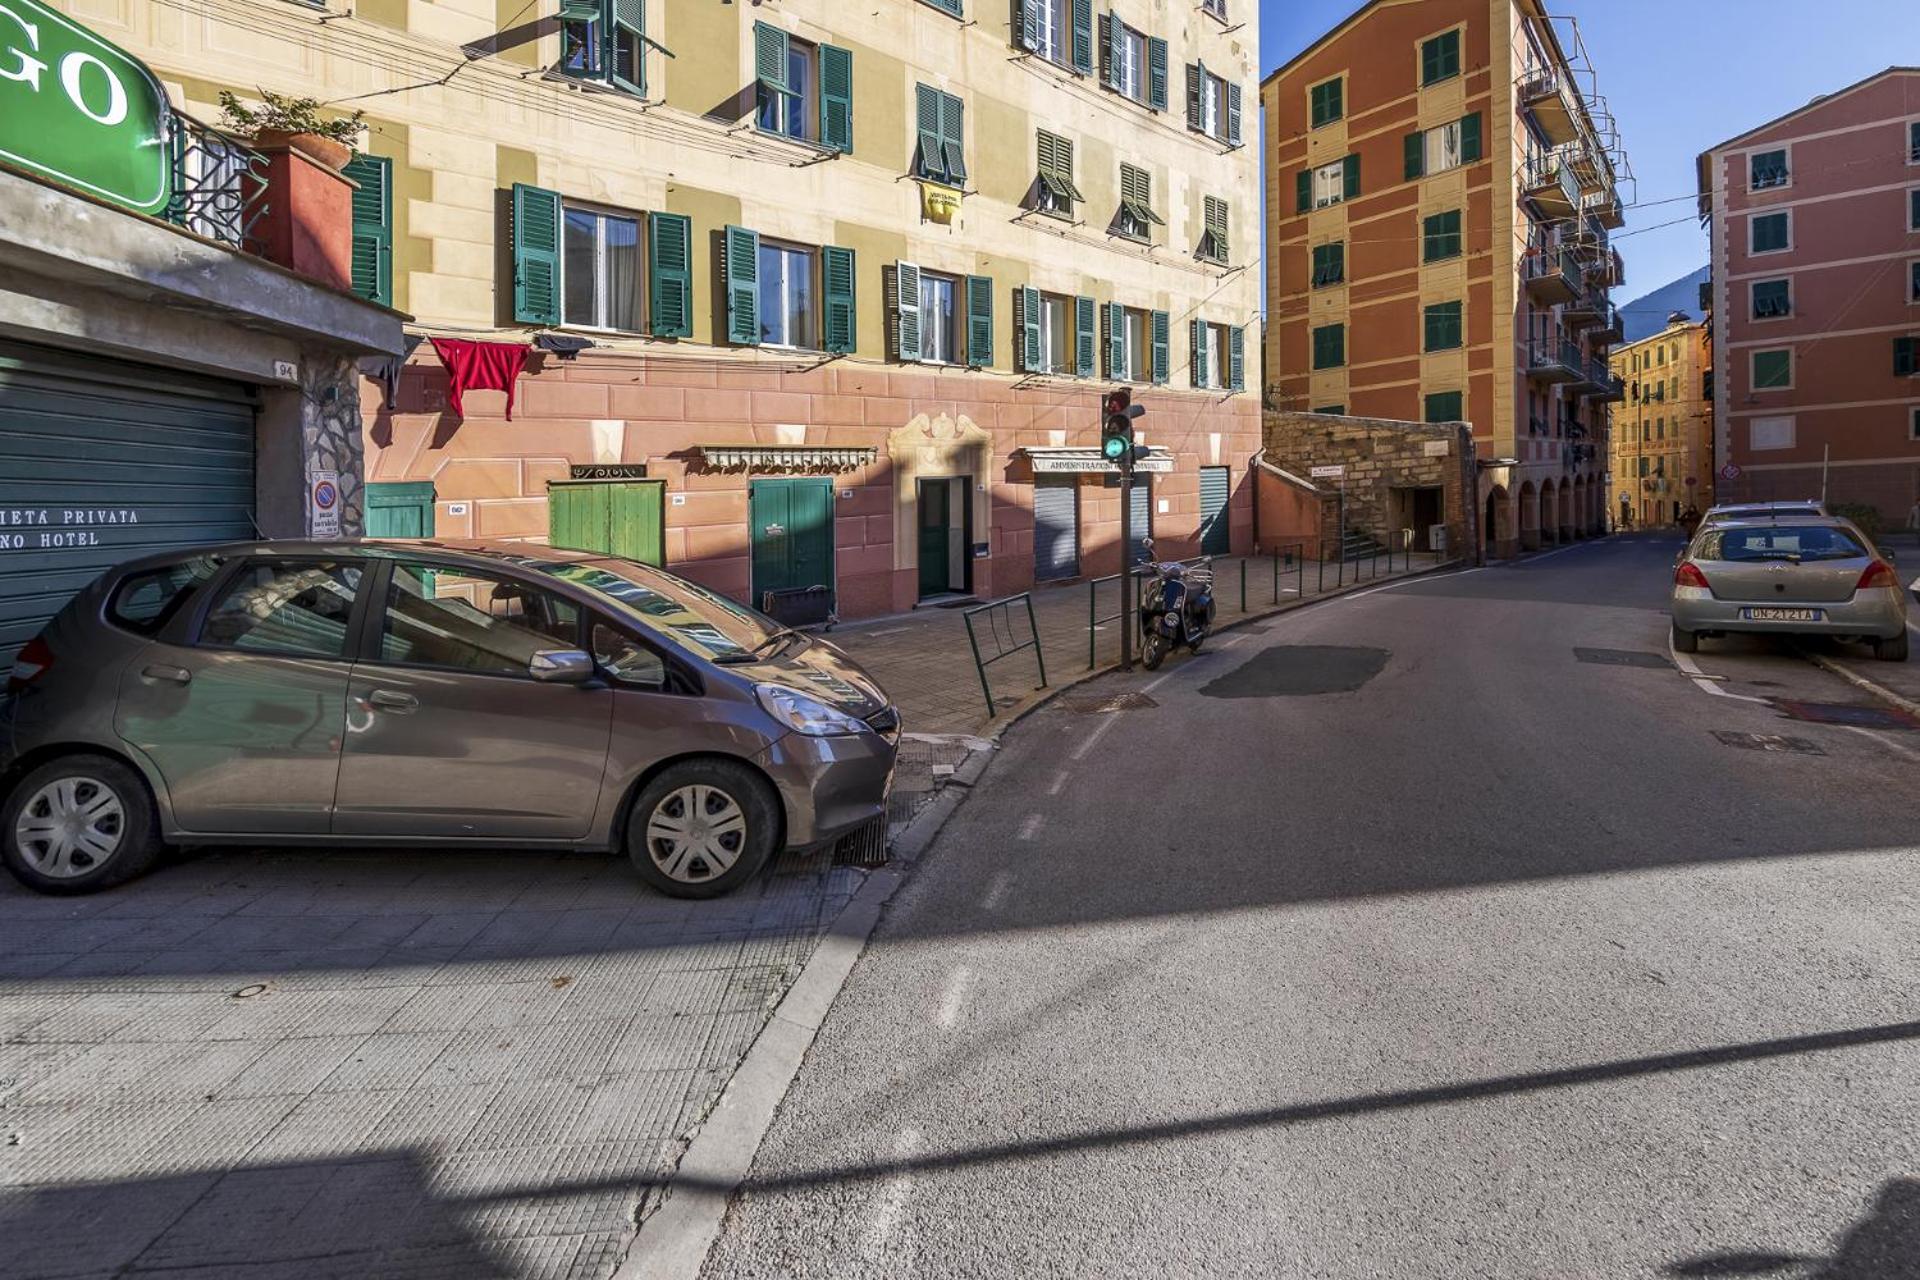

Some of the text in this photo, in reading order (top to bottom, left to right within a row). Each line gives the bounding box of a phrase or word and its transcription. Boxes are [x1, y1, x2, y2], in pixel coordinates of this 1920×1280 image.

[280, 364, 292, 376] 94
[64, 510, 138, 524] PRIVATA
[0, 532, 99, 549] NO HOTEL
